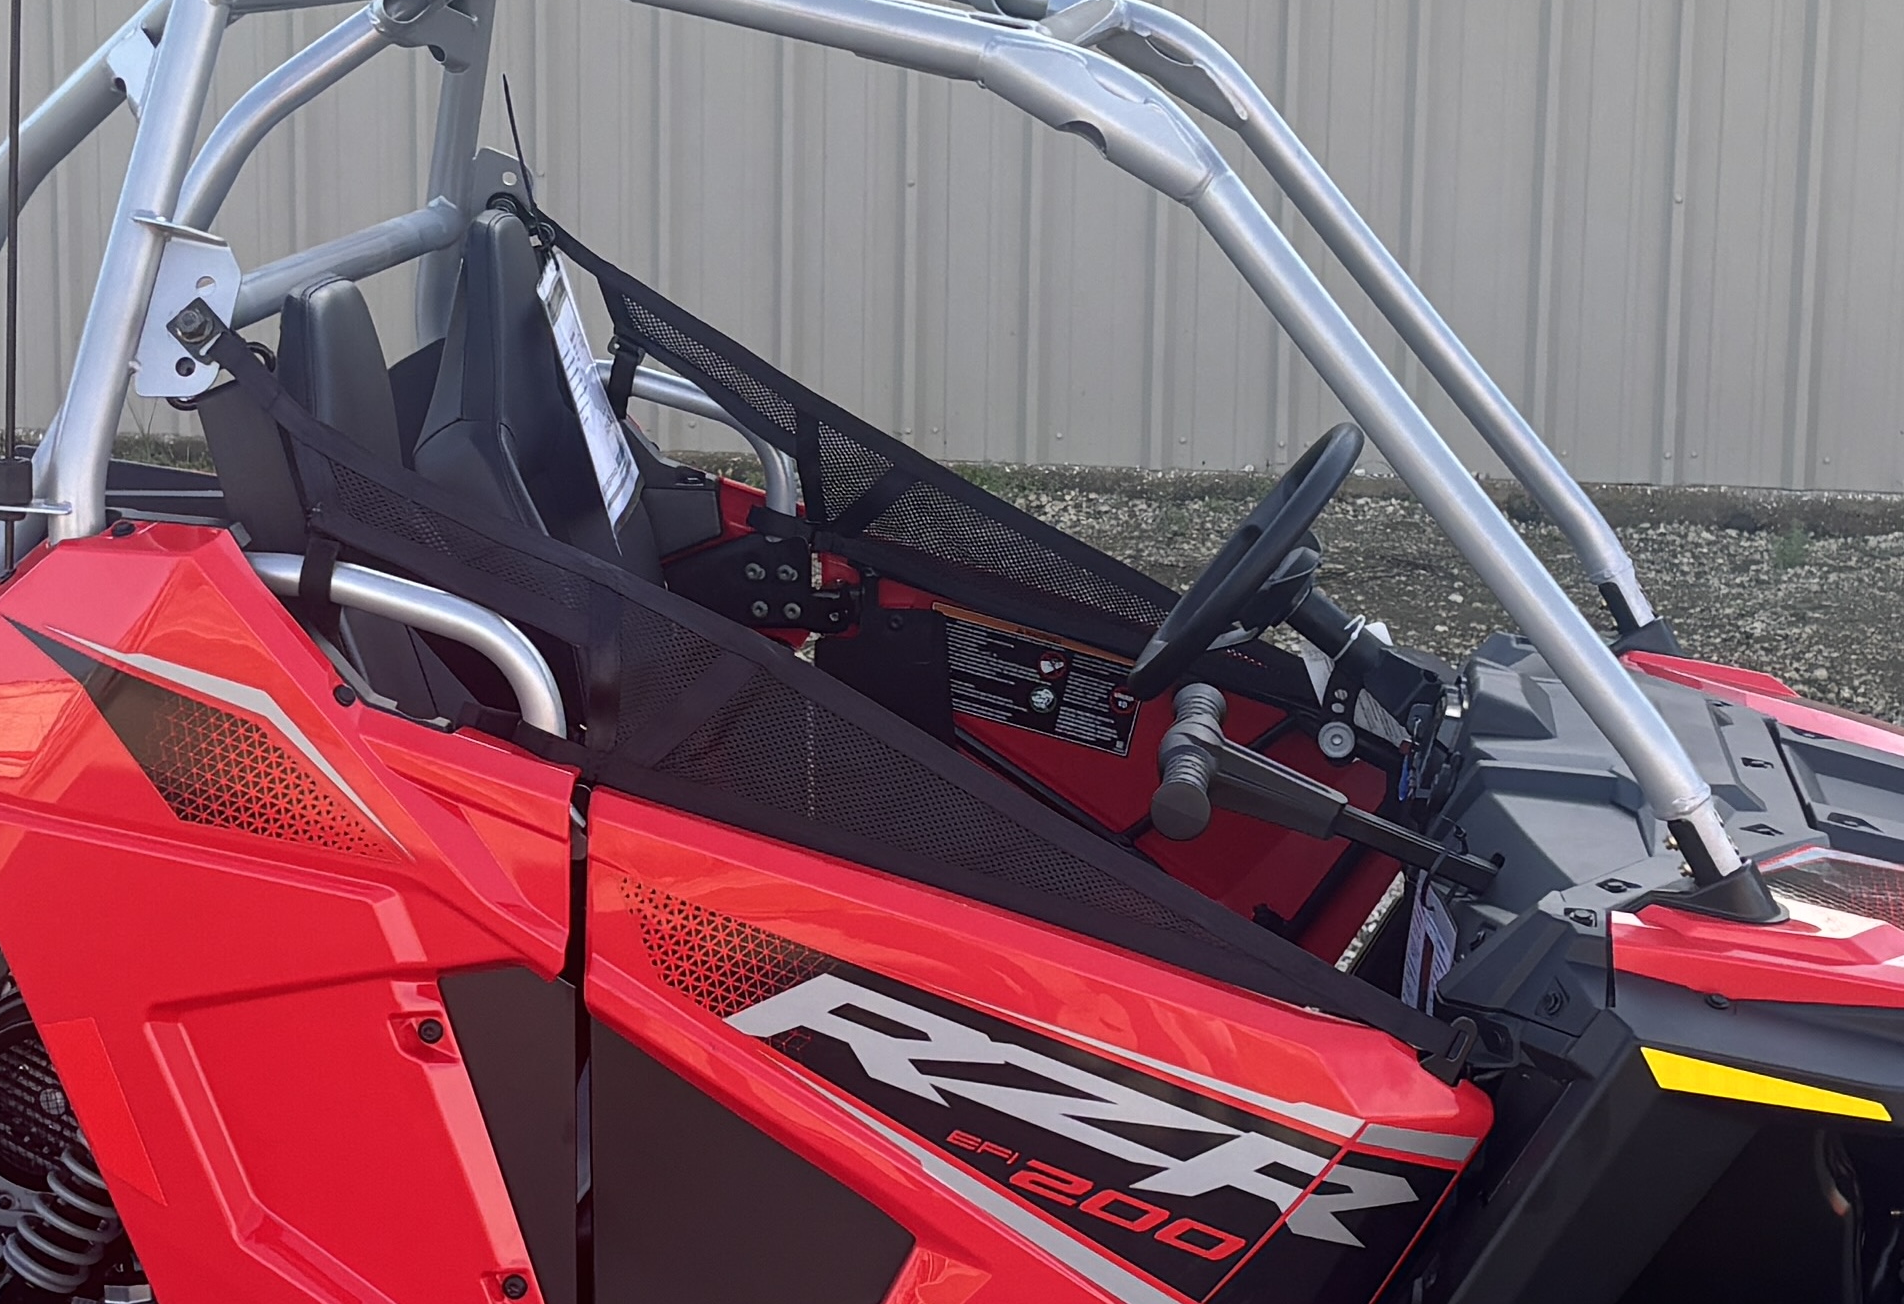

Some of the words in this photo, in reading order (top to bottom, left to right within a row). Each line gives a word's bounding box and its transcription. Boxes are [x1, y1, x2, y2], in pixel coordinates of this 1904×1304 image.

[721, 972, 1419, 1248] RZR
[946, 1129, 1019, 1165] EFI
[1008, 1158, 1247, 1262] 200
